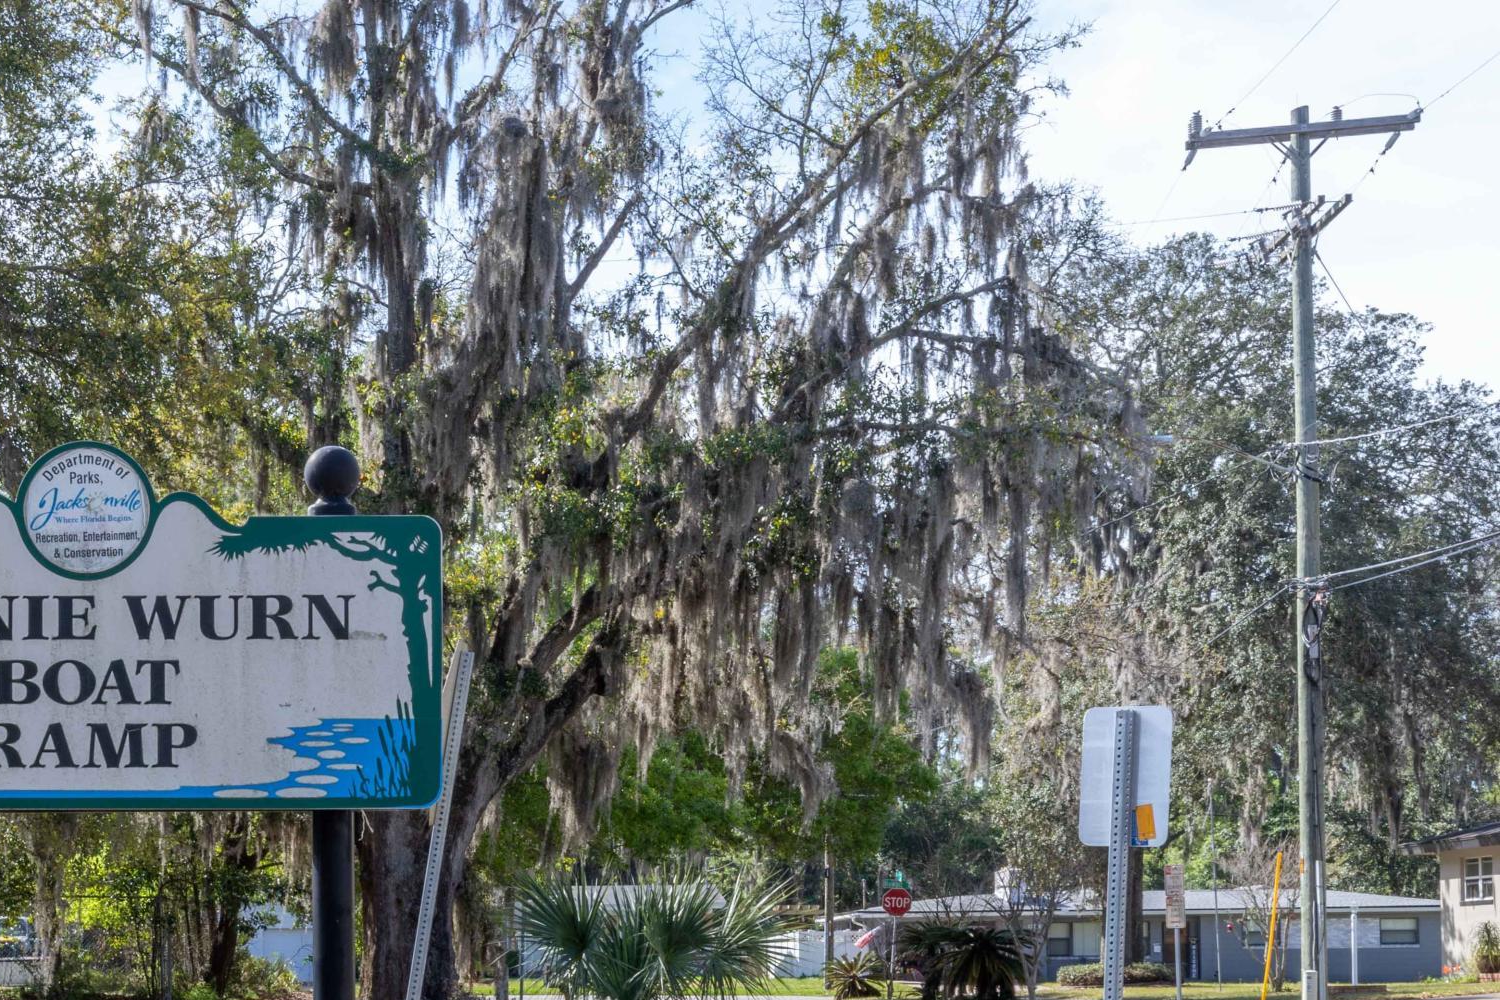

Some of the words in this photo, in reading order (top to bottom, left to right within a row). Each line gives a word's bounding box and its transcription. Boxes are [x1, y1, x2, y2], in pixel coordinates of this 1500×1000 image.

[42, 453, 115, 482] Department
[115, 468, 131, 480] of
[69, 471, 104, 486] Parks,
[55, 516, 79, 524] Where
[80, 515, 106, 524] Florida
[35, 532, 81, 544] Recreation,
[82, 531, 140, 543] Entertainment,
[53, 549, 61, 559] &
[63, 548, 124, 559] Conservation
[121, 594, 357, 642] WURN
[884, 897, 910, 908] STOP
